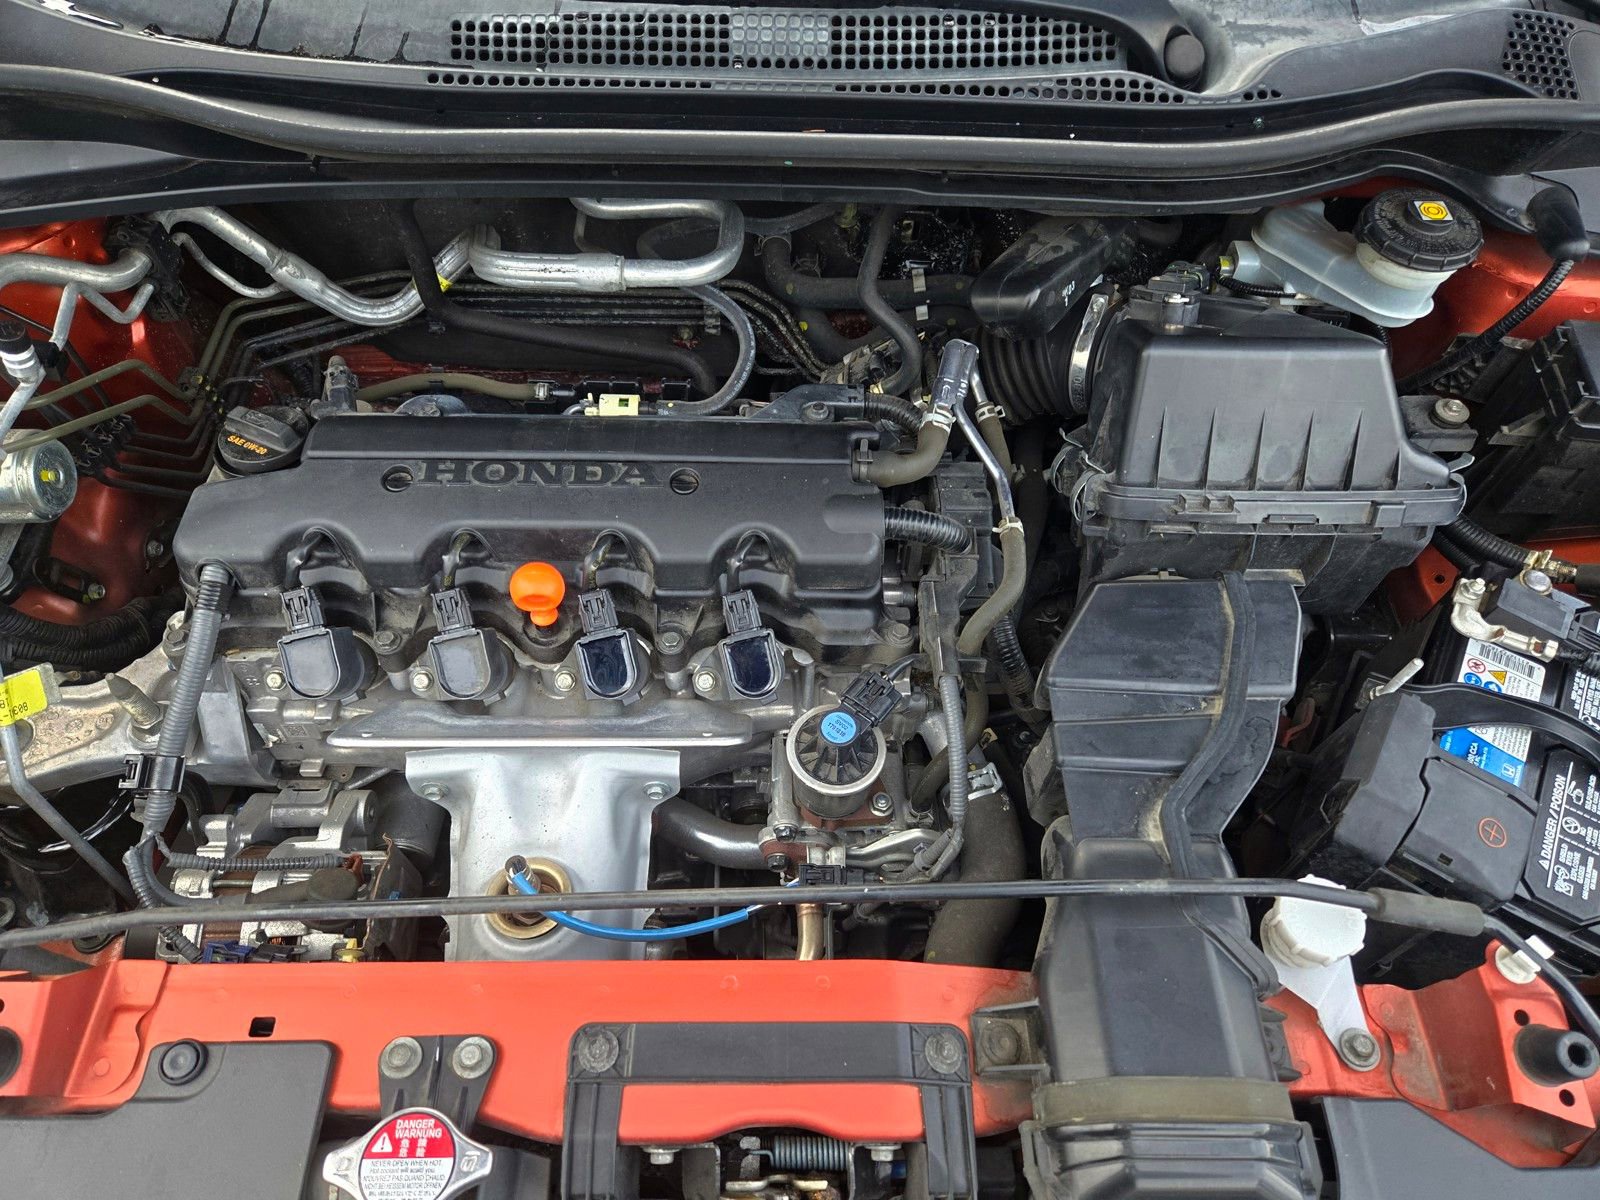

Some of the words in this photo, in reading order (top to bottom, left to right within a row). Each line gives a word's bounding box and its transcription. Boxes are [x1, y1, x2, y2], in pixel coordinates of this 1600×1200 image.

[227, 435, 245, 446] SAE
[243, 440, 268, 455] 0W-20
[416, 460, 664, 487] HONDA
[1469, 742, 1479, 755] CCA
[1542, 818, 1558, 857] DANGER
[1550, 774, 1566, 811] POISON
[396, 1119, 435, 1129] DANGER
[395, 1128, 442, 1139] WARNUNG
